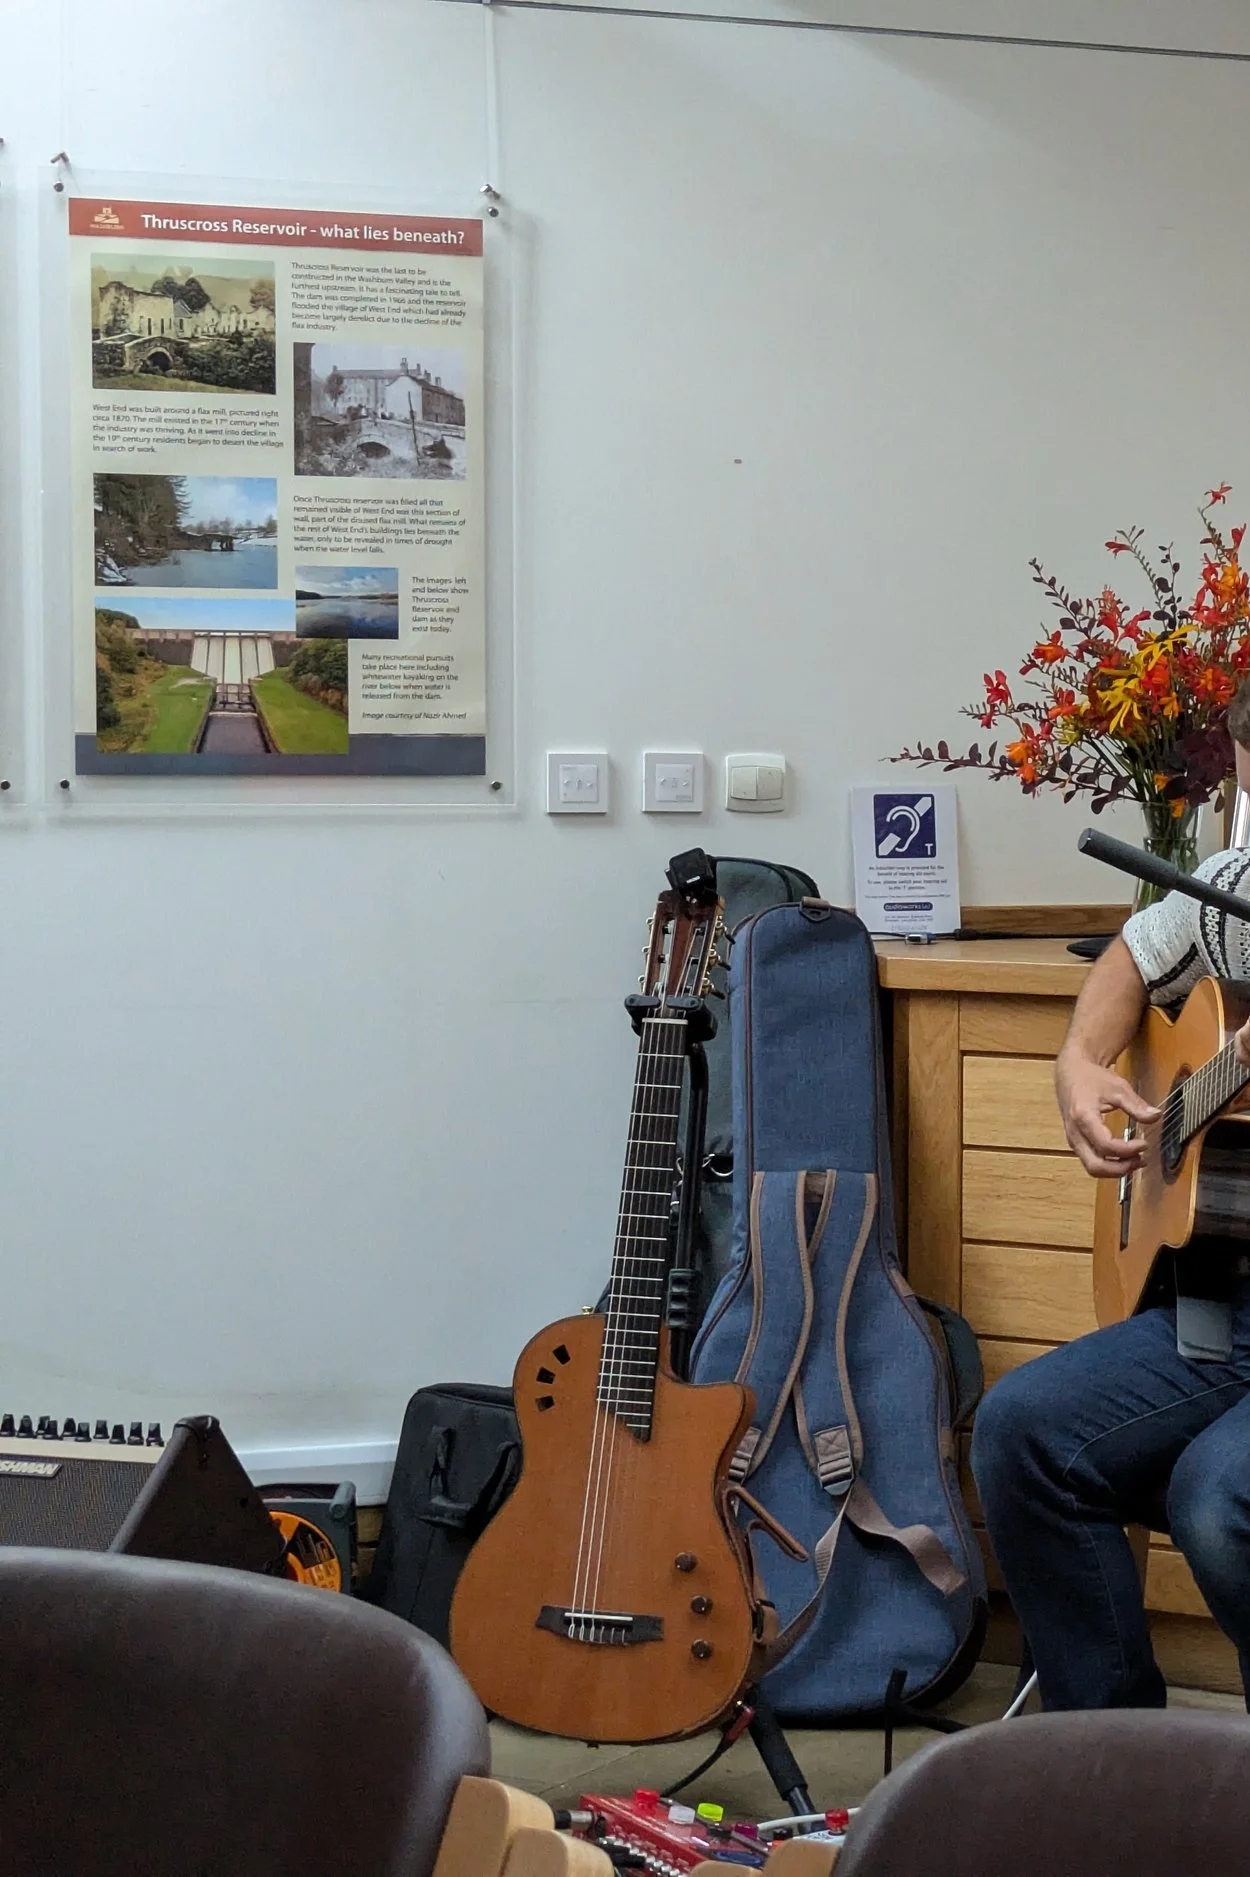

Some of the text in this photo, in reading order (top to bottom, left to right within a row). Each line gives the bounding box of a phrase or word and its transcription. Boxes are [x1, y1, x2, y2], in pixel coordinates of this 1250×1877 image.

[141, 215, 228, 231] Thruscross
[233, 220, 307, 235] Reservoir
[320, 224, 359, 238] what
[364, 226, 388, 240] lies
[394, 228, 464, 243] beneath?
[925, 844, 933, 855] T
